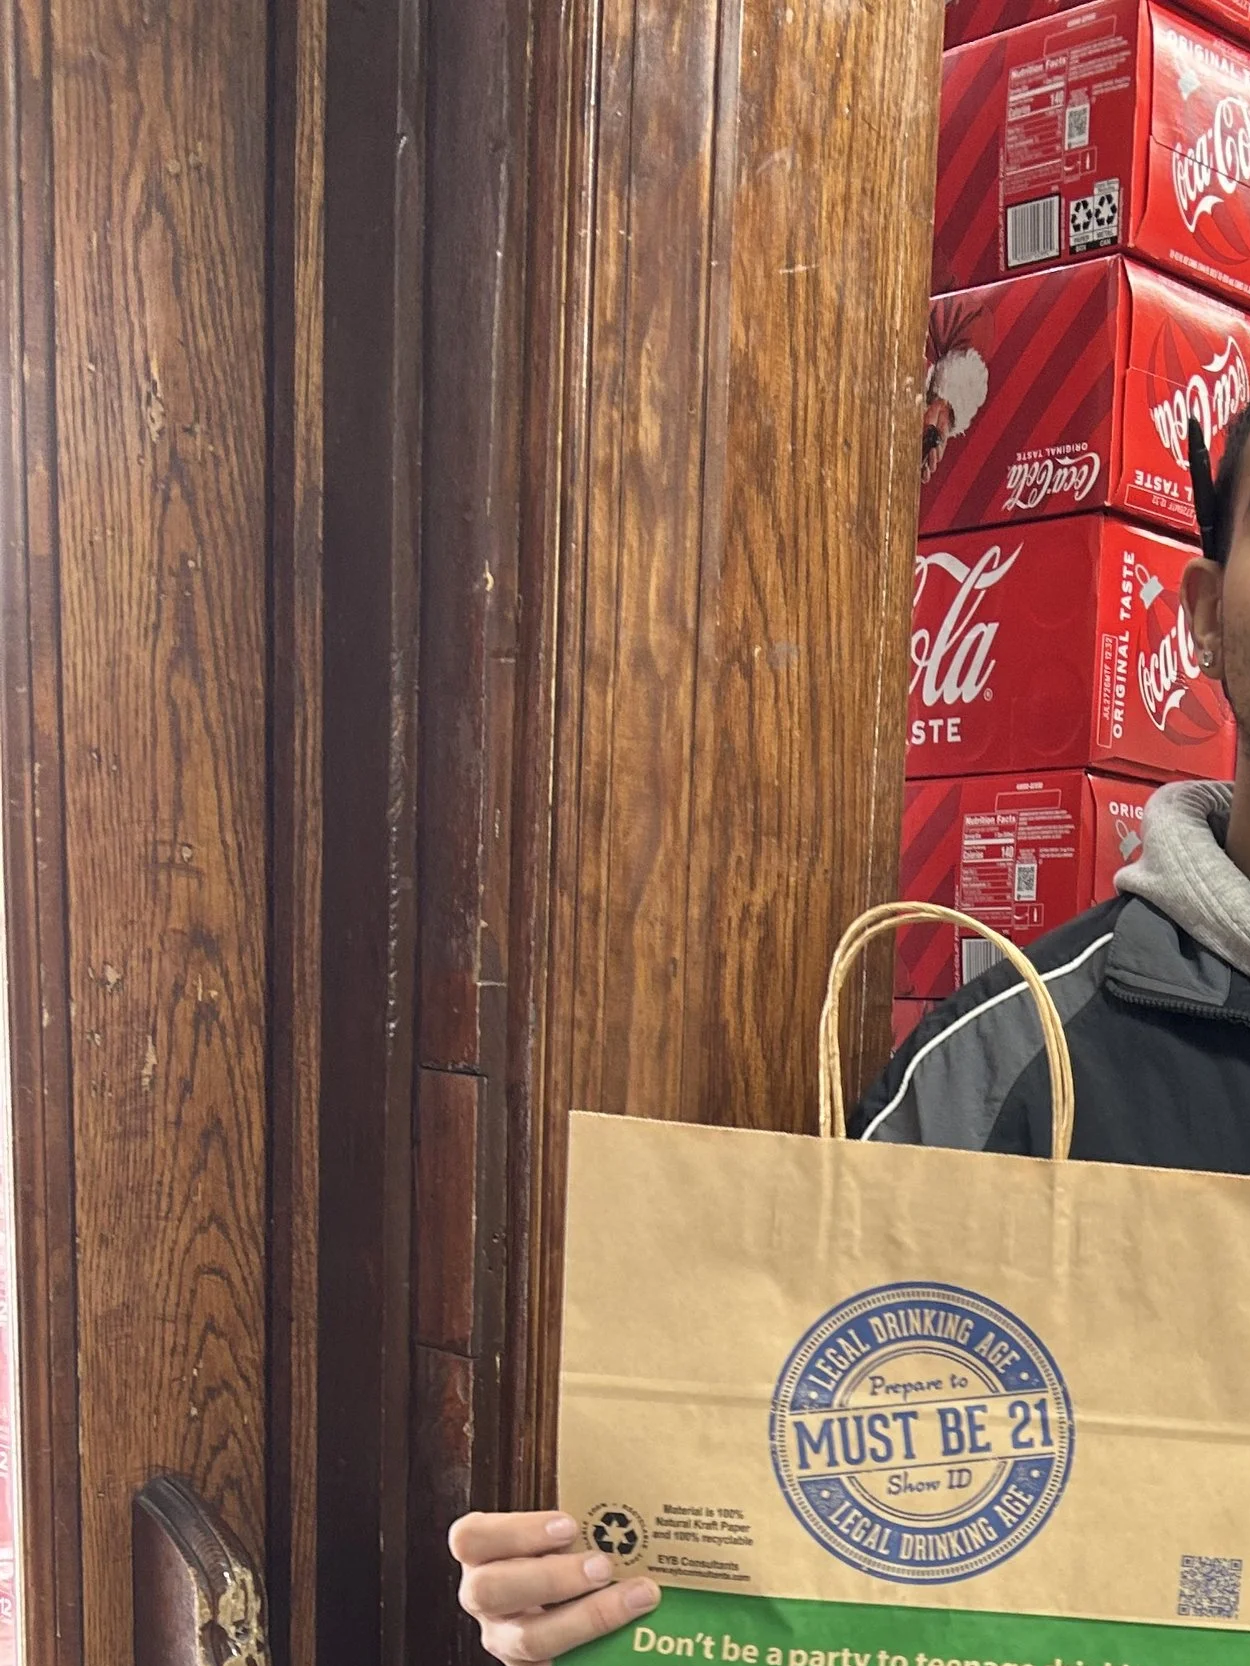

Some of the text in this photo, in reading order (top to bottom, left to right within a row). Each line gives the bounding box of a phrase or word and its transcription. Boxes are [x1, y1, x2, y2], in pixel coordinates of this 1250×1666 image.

[1049, 442, 1089, 458] ORIGINAL
[1002, 452, 1101, 511] Coca-Cola
[1134, 470, 1181, 496] TASTE
[1111, 551, 1136, 740] ORIGINAL TASTE
[1109, 802, 1144, 819] ORIG
[808, 1308, 1021, 1391] LEGAL DRINKING AGE
[869, 1373, 969, 1401] Prepare to
[793, 1397, 1053, 1470] MUST BE 21
[887, 1468, 973, 1495] Show ID
[656, 1517, 751, 1533] Natural Kraft Paper
[663, 1503, 703, 1517] Material
[717, 1507, 744, 1520] 100%
[828, 1484, 1034, 1561] LEGAL DRINKING AGE
[652, 1530, 671, 1540] and
[701, 1534, 754, 1546] recyclable
[633, 1626, 715, 1660] Don't
[722, 1634, 759, 1662] be
[766, 1647, 783, 1666] a
